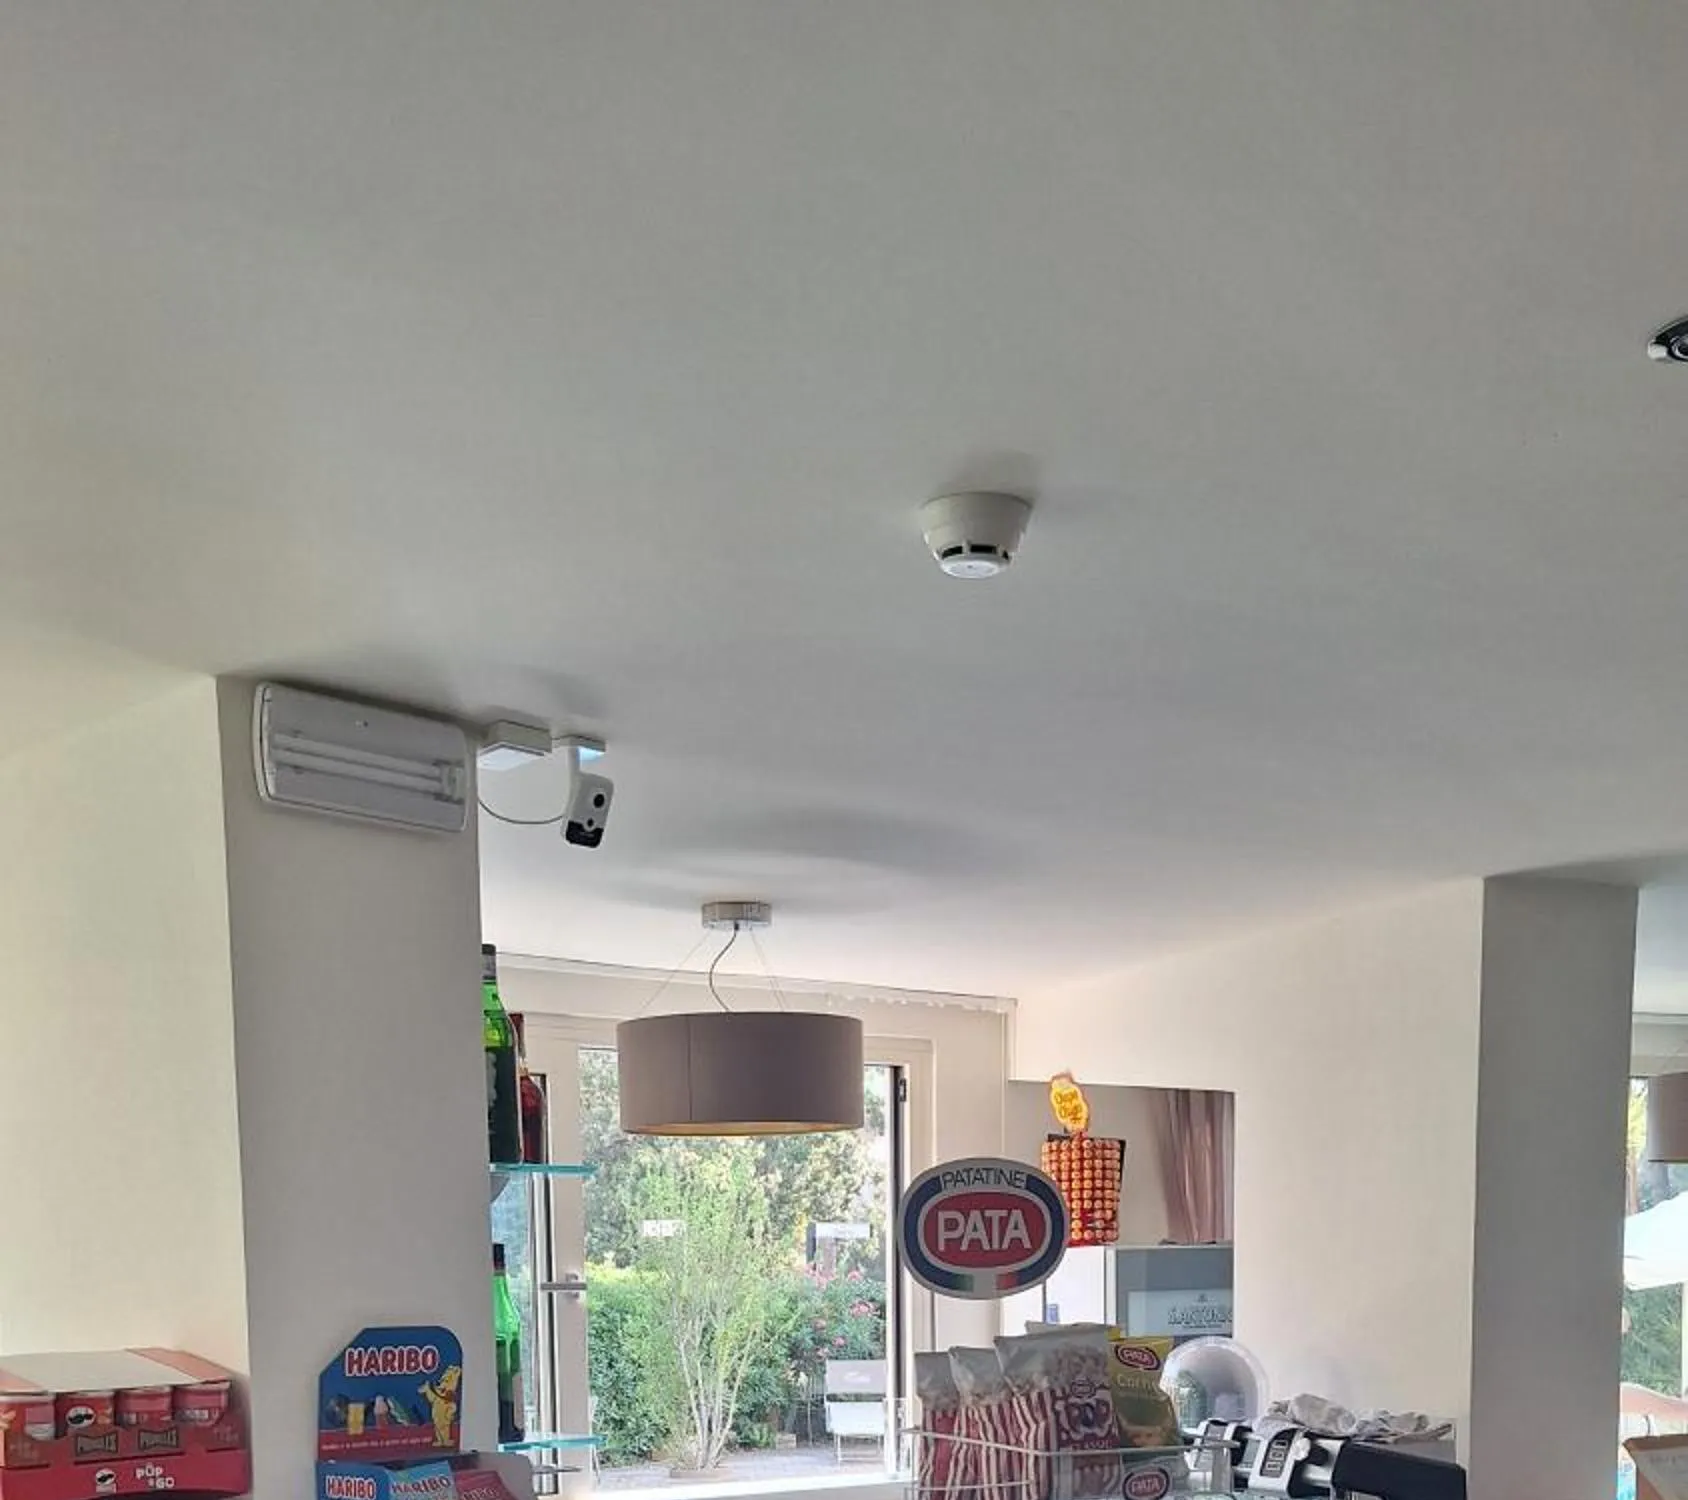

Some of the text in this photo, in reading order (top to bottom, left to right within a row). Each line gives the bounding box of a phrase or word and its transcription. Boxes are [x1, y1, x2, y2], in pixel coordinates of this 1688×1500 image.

[942, 1167, 1026, 1189] PATATINE
[938, 1209, 1032, 1252] PATA
[346, 1346, 439, 1376] HARIBO
[136, 1462, 163, 1480] POP
[391, 1475, 451, 1494] HARIBO
